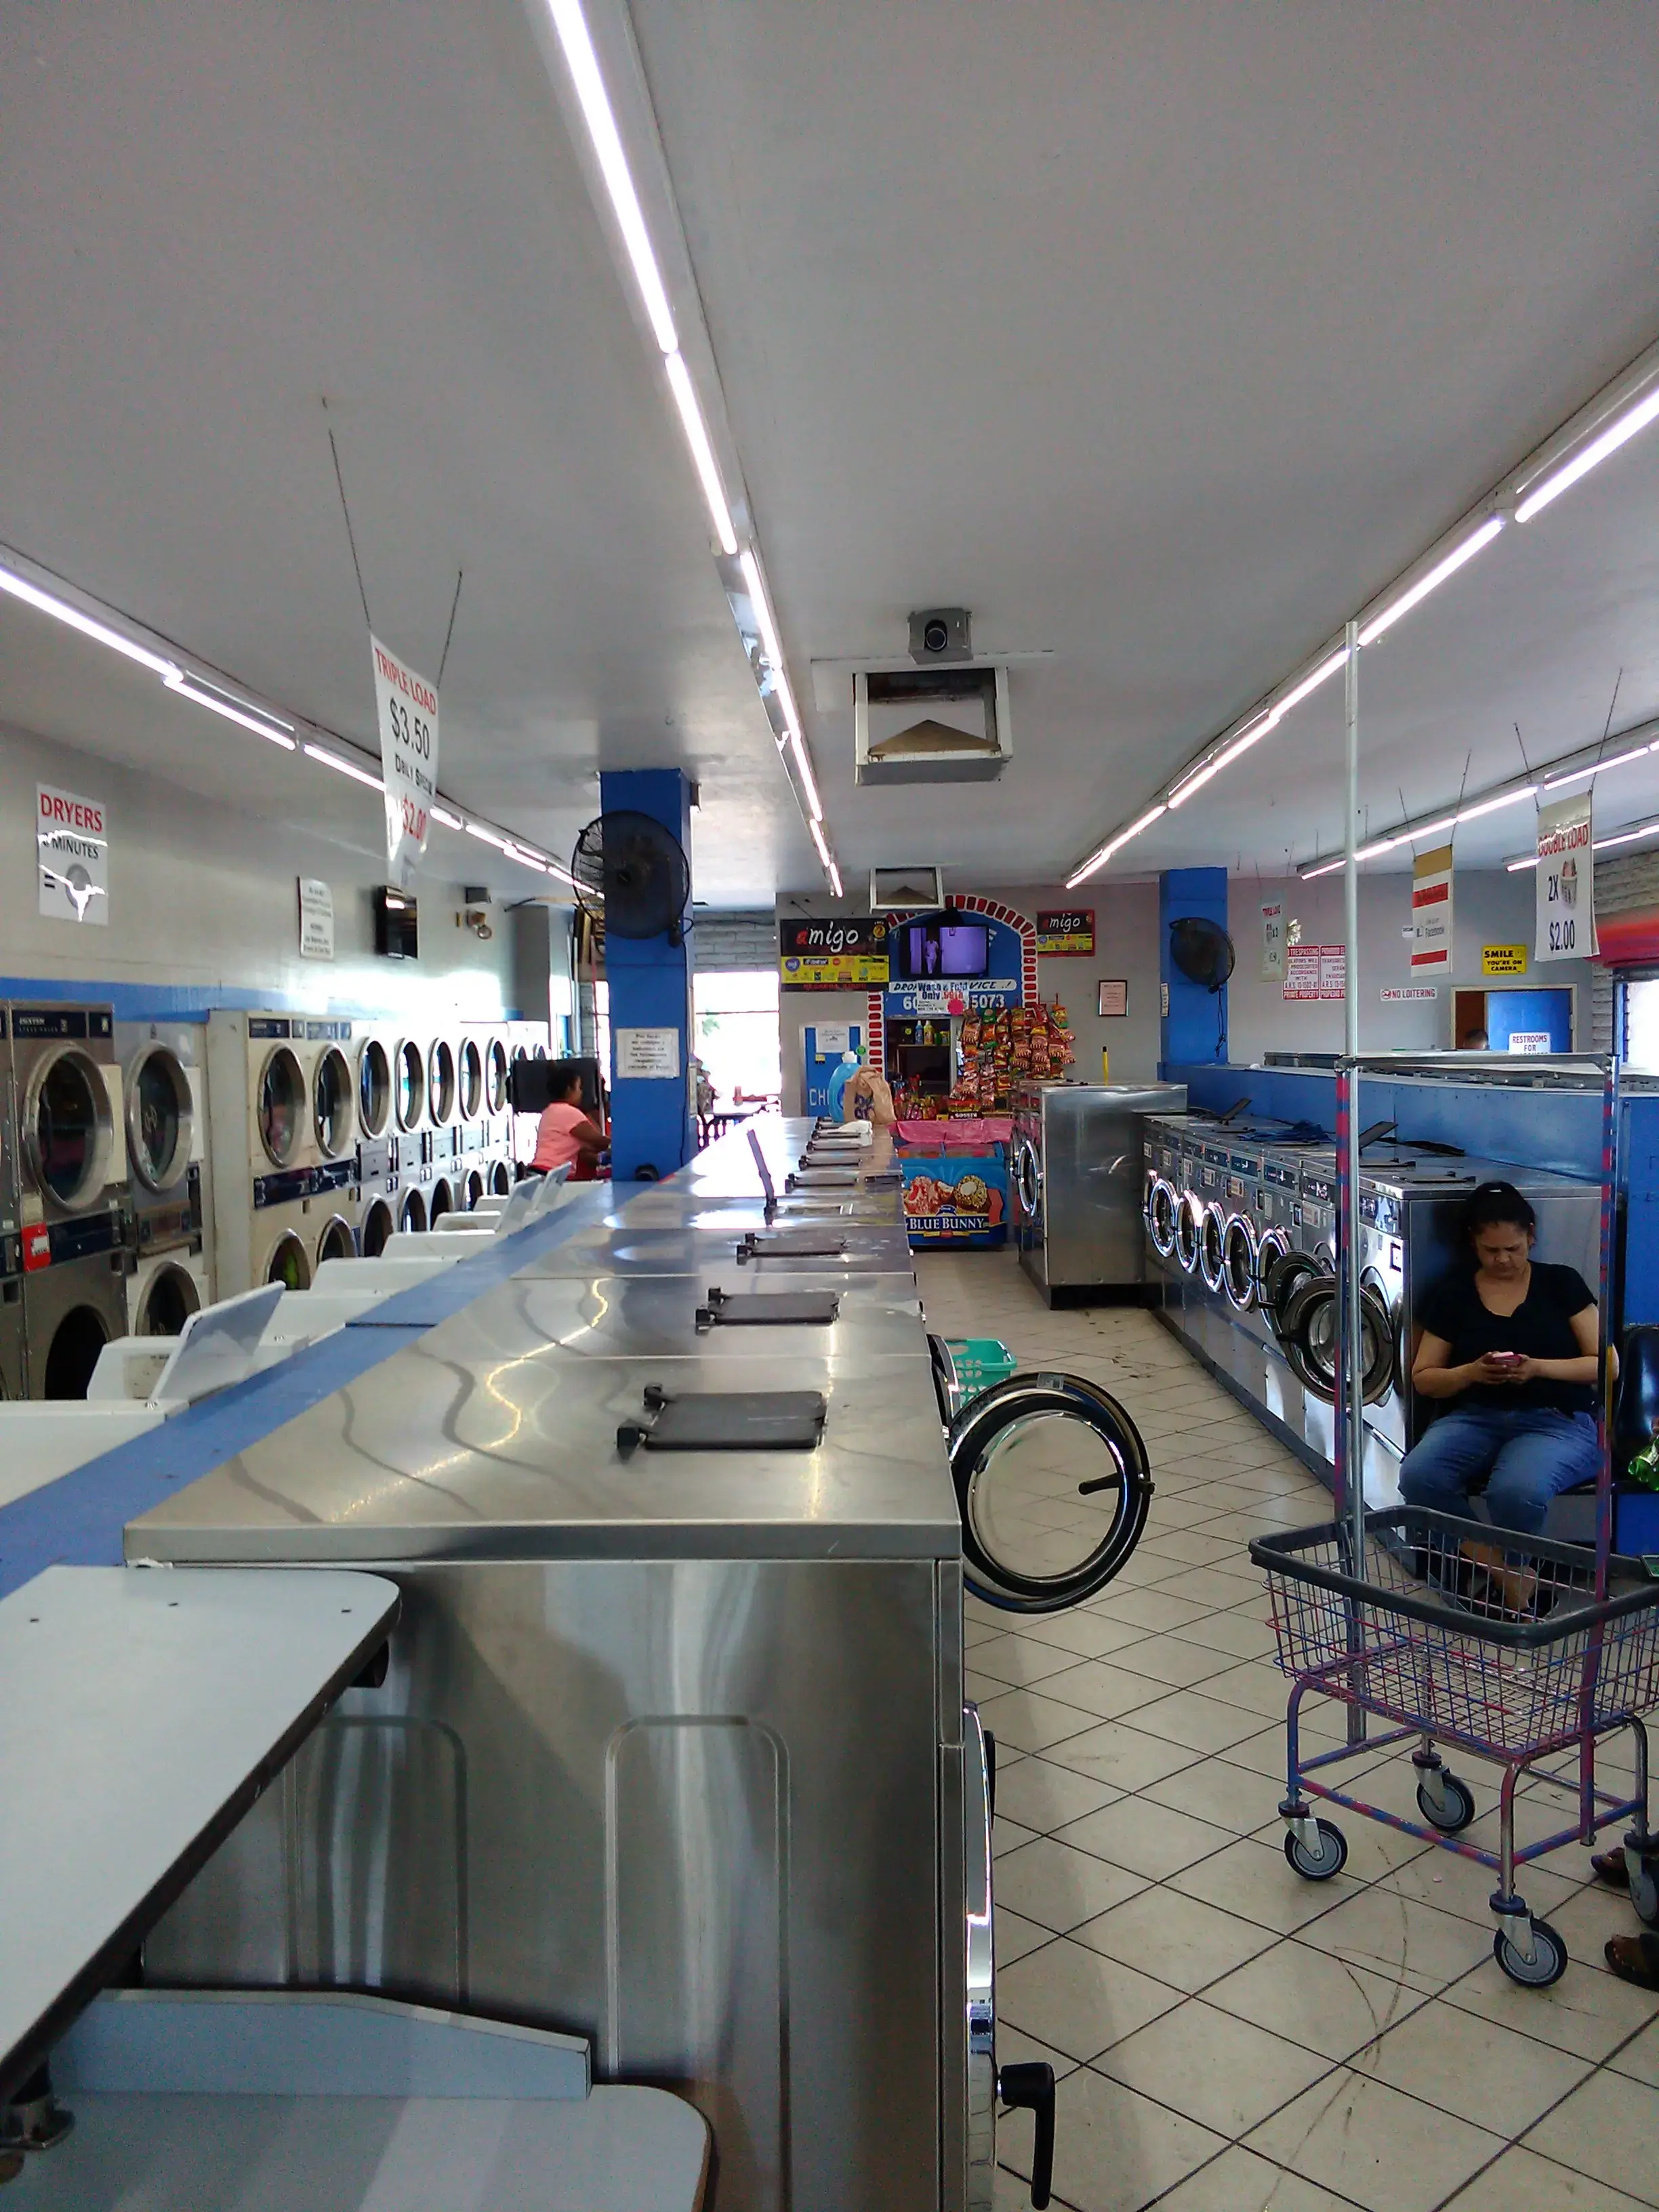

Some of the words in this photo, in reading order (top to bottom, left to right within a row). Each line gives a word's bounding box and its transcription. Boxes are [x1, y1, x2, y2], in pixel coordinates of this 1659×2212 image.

[375, 648, 409, 696] TRIPLE
[409, 677, 436, 716] LOAD
[390, 697, 430, 760] $3.50
[40, 793, 103, 833] DRYERS
[52, 836, 99, 860] MINUTES
[1538, 833, 1565, 857] DOUBLE
[1567, 824, 1589, 851] LOAD
[1548, 874, 1559, 902] 2X
[1043, 913, 1081, 933] amigo
[796, 920, 859, 954] amigo
[1549, 919, 1575, 953] $2.00
[1484, 950, 1514, 958] SMILE
[918, 983, 941, 991] Wash
[950, 982, 968, 991] Fold
[969, 981, 997, 989] VICE
[1392, 989, 1401, 998] NO
[1402, 989, 1435, 998] LOITERING
[922, 991, 940, 1000] Only
[970, 994, 1004, 1009] 5073
[1512, 1035, 1547, 1044] RESTROOMS
[909, 1218, 939, 1229] BLUE
[942, 1217, 983, 1229] BUNNY
